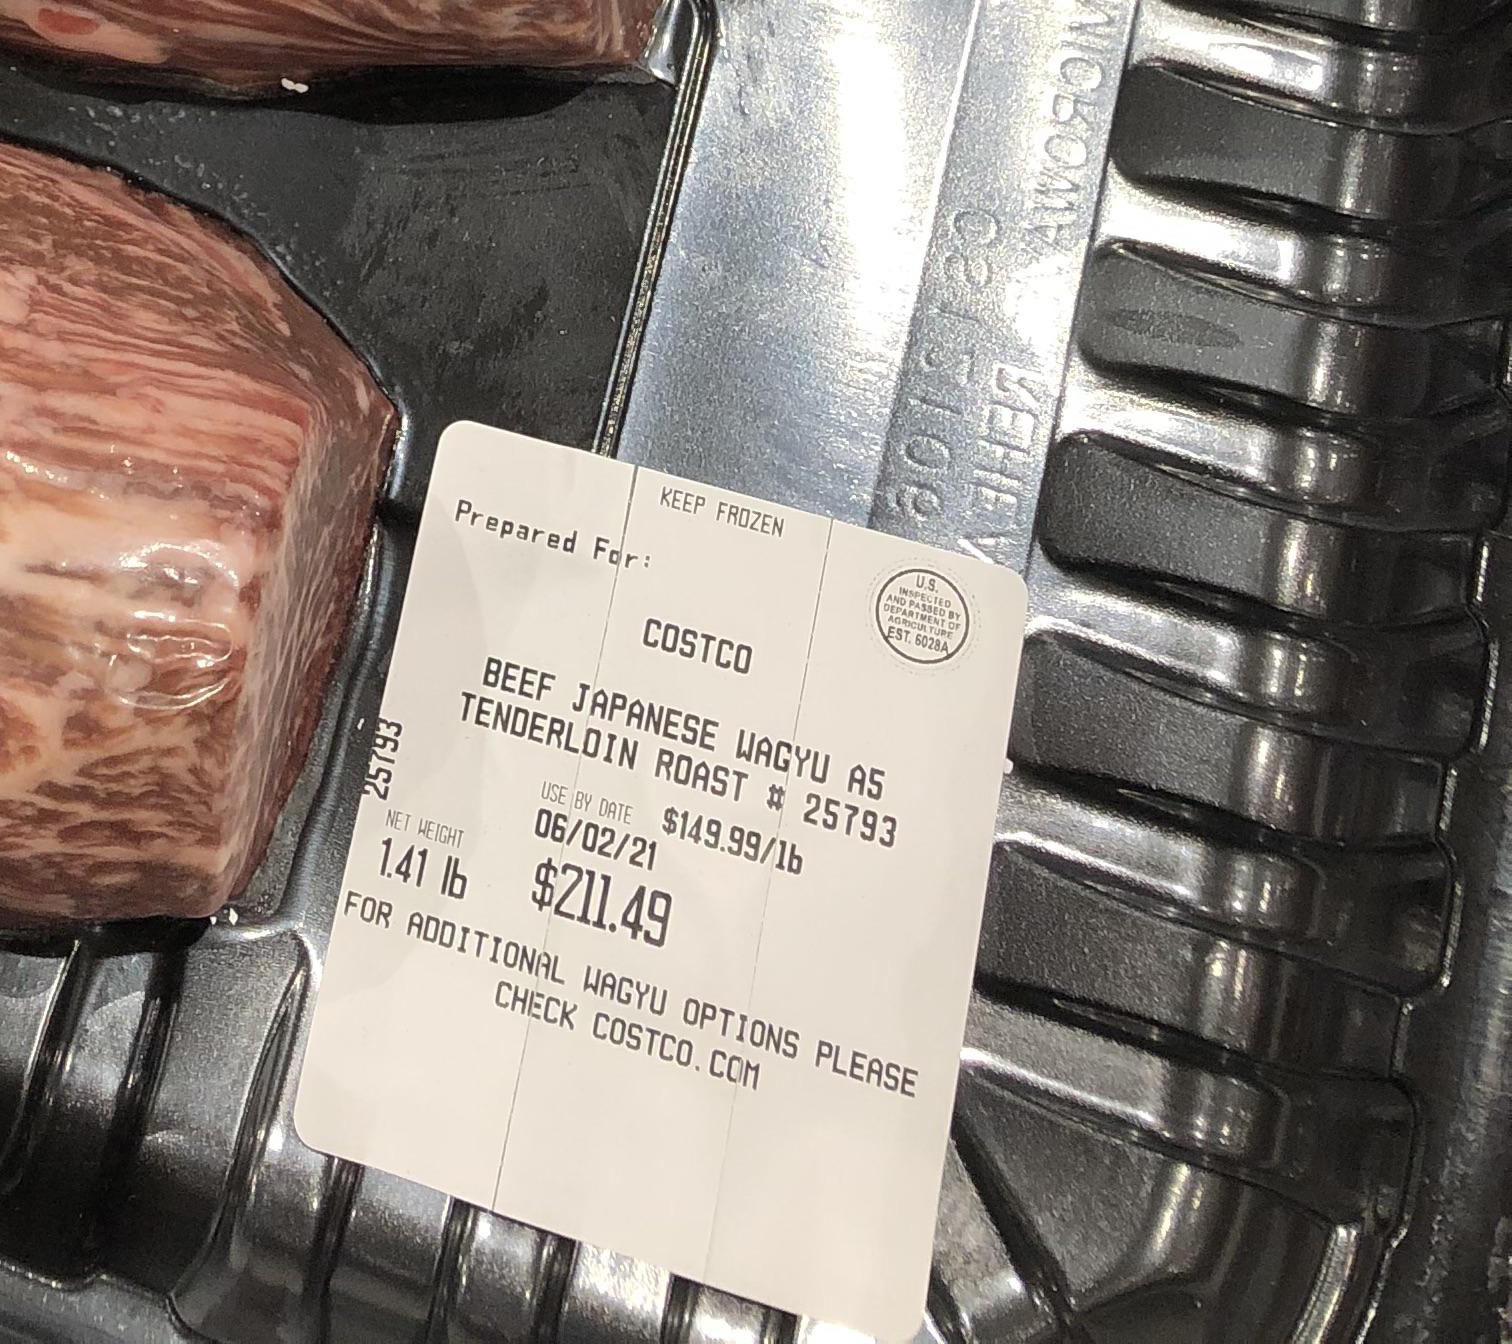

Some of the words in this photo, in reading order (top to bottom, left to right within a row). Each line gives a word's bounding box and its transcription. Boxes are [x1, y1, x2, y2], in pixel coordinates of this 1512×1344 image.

[455, 499, 578, 554] Prepared
[592, 536, 653, 569] For:
[659, 486, 706, 515] KEEP
[715, 501, 785, 538] FROZEN
[886, 594, 907, 607] AND
[909, 600, 946, 617] PASSED
[948, 610, 961, 621] BY
[899, 586, 952, 608] INSPECTED
[915, 574, 939, 593] U.S.
[883, 603, 946, 628] DEPARTMENT
[948, 621, 961, 631] OF
[887, 626, 911, 644] EST.
[914, 633, 950, 656] 6028A
[888, 615, 954, 640] AGRICULTURE
[642, 618, 753, 675] COSTCO
[482, 656, 556, 701] BEEF
[571, 682, 720, 752] JAPANESE
[735, 728, 831, 785] WAGYU
[847, 764, 886, 801] A5
[461, 691, 639, 770] TENDERLOIN
[654, 747, 749, 802] ROAST
[766, 783, 787, 812] #
[803, 792, 897, 848] 25793
[385, 808, 412, 832] NET
[417, 817, 465, 849] WEIGHT
[540, 780, 569, 806] USE
[574, 792, 593, 814] BY
[598, 797, 634, 825] DATE
[534, 807, 657, 871] 06/02/21
[379, 837, 429, 888] 1.41
[440, 855, 468, 900] lb
[531, 856, 673, 948] $211.49
[343, 890, 393, 929] FOR
[406, 911, 565, 985] ADDITIONAL
[583, 965, 668, 1017] WAGYU
[682, 997, 800, 1060] OPTIONS
[815, 1041, 919, 1098] PLEASE
[495, 980, 578, 1031] CHECK
[592, 1012, 761, 1091] COSTCO.COM
